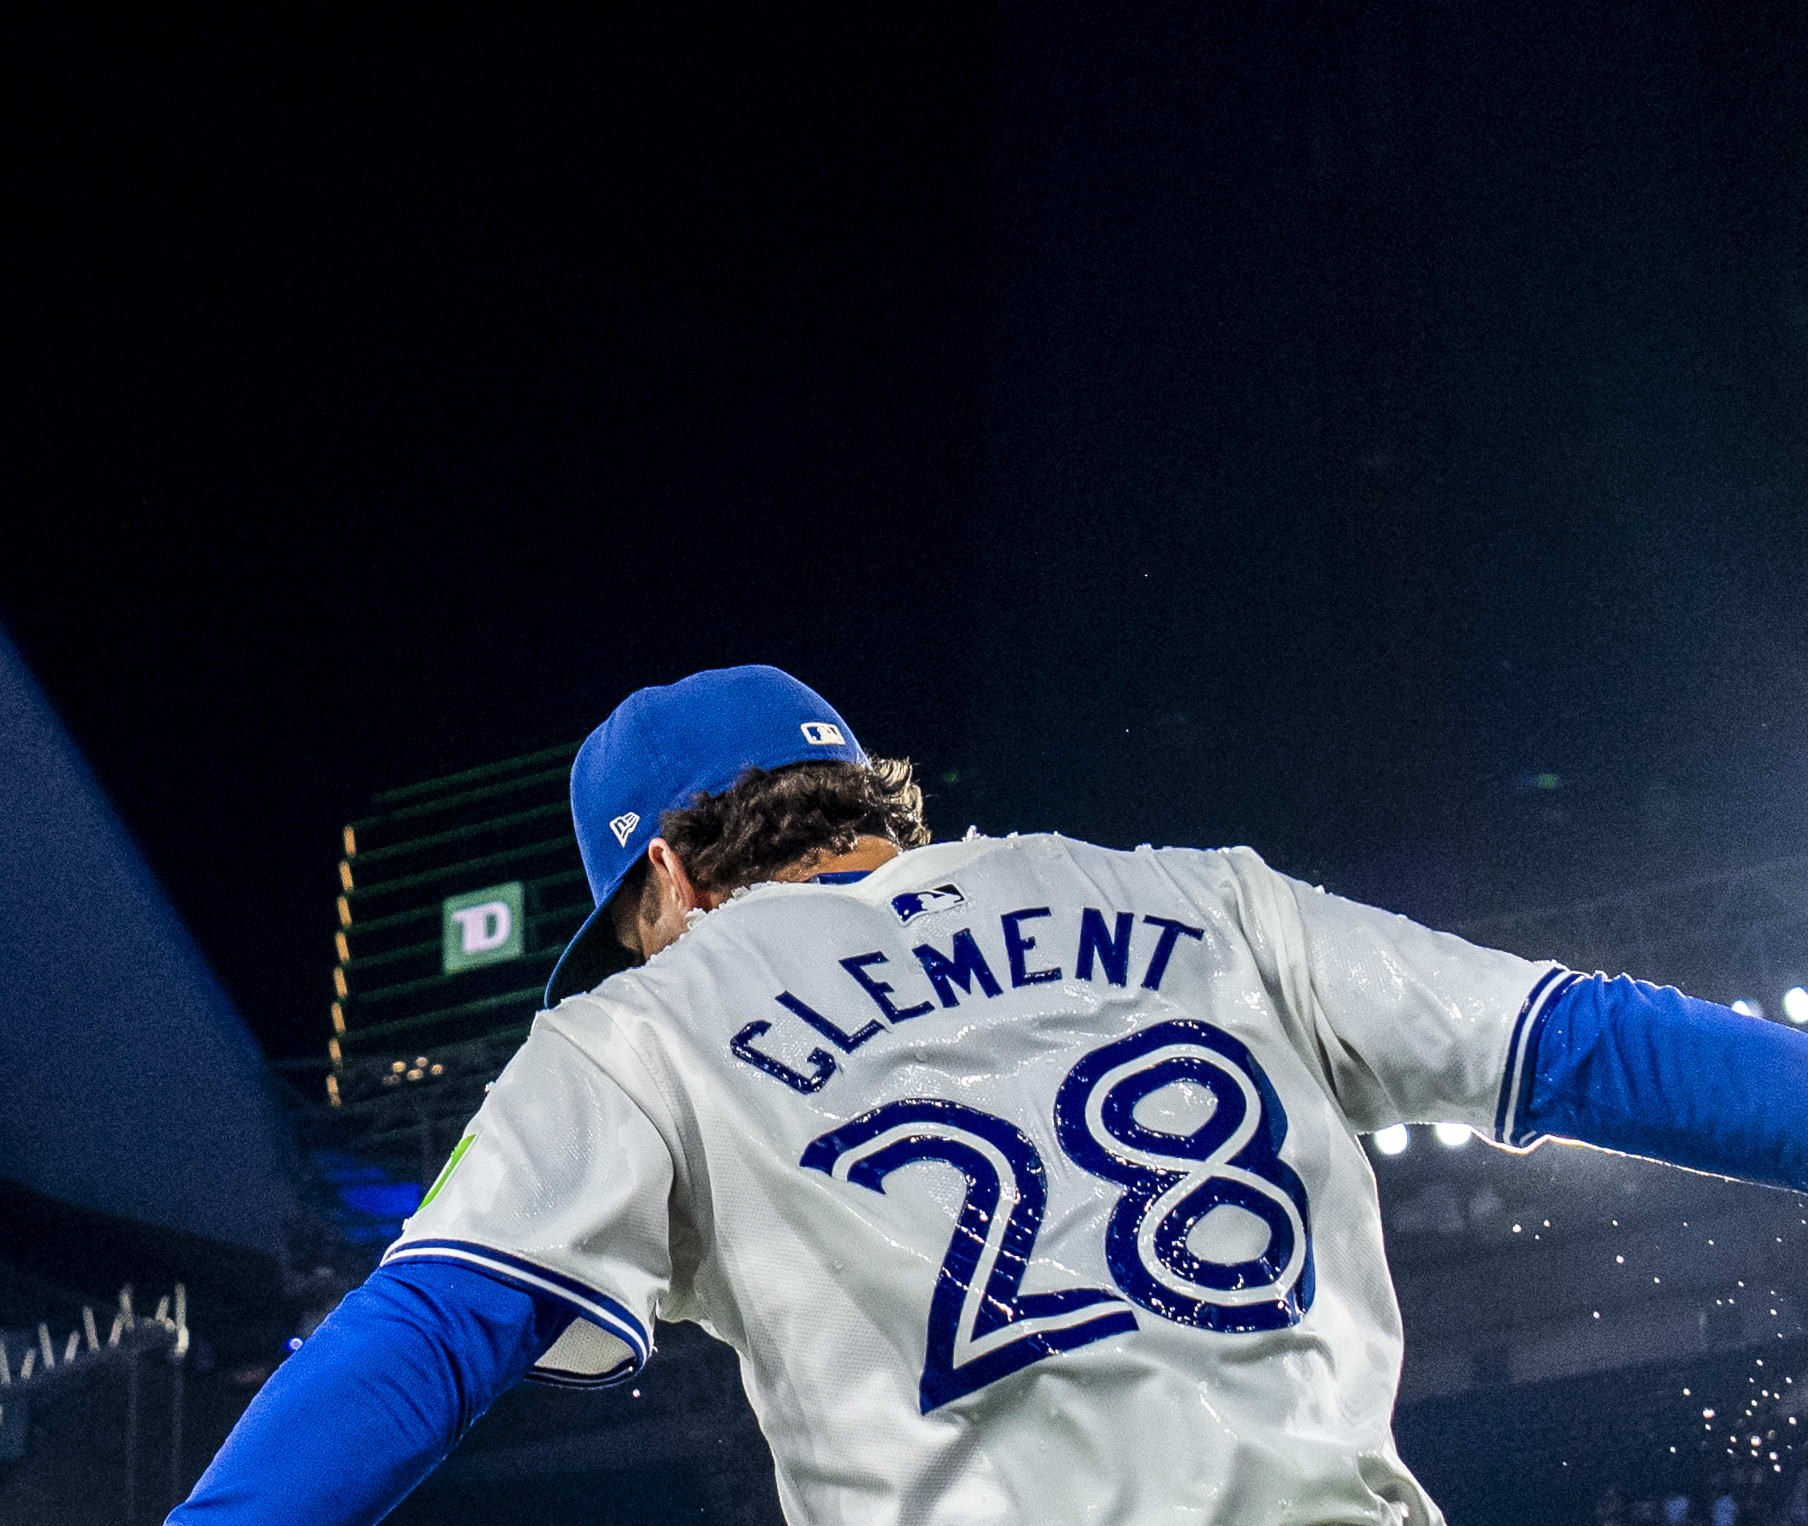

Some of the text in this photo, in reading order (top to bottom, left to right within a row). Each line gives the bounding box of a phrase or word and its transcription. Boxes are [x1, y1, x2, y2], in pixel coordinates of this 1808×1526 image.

[452, 899, 511, 956] TD
[729, 907, 1205, 1095] CLEMENT
[799, 1019, 1316, 1415] 28
